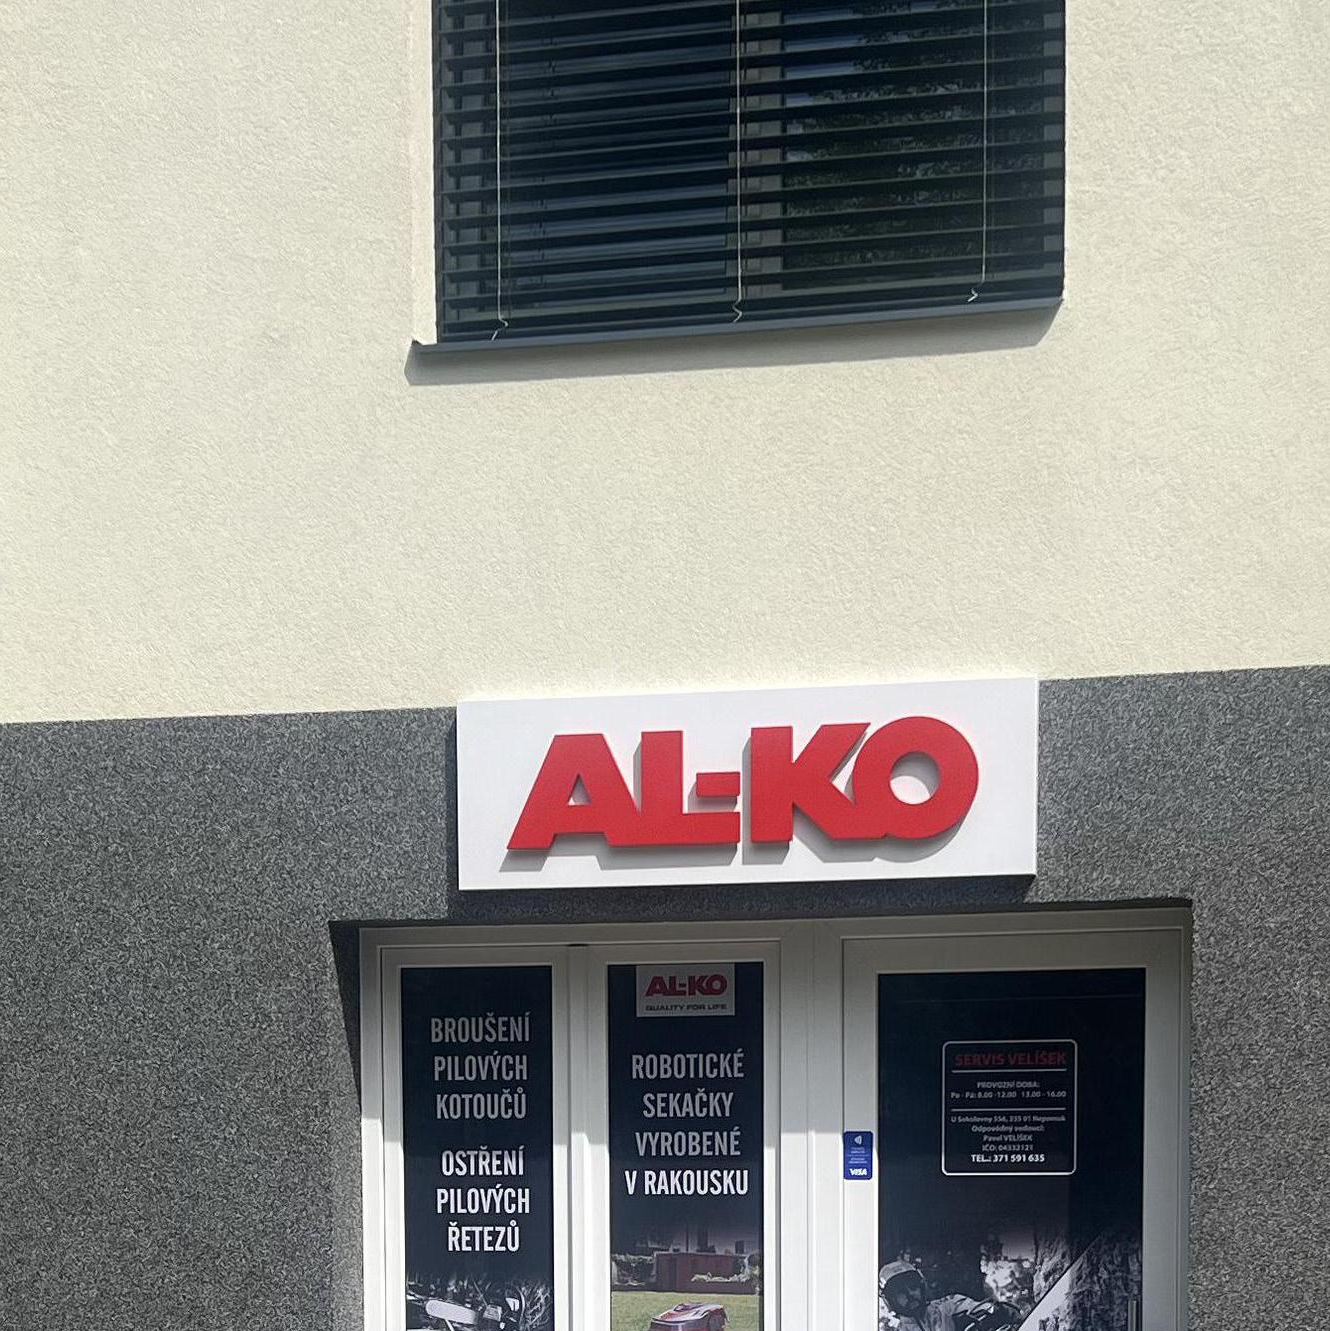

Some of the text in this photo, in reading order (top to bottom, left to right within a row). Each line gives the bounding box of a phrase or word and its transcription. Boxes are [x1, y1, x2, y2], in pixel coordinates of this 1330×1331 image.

[506, 716, 979, 850] AL-KO
[645, 974, 728, 998] AL-KO
[645, 1004, 685, 1012] QUALITY
[686, 1003, 706, 1011] FOR
[430, 1011, 531, 1043] BROUŠENÍ
[434, 1050, 528, 1081] PILOVÝCH
[632, 1048, 745, 1080] ROBOTICKÉ
[955, 1050, 1066, 1066] SERVIS VELÍŠEK
[436, 1087, 527, 1120] KOTOUČŮ
[642, 1088, 734, 1118] SEKAČKY
[635, 1126, 741, 1156] VYROBENÉ
[441, 1145, 525, 1177] OSTŘENÍ
[993, 1154, 1009, 1162] 371
[1011, 1154, 1027, 1162] 591
[1028, 1154, 1045, 1162] 635
[624, 1169, 749, 1196] V RAKOUSKU
[436, 1184, 530, 1214] PILOVÝCH
[447, 1219, 520, 1252] ŘETEZŮ
